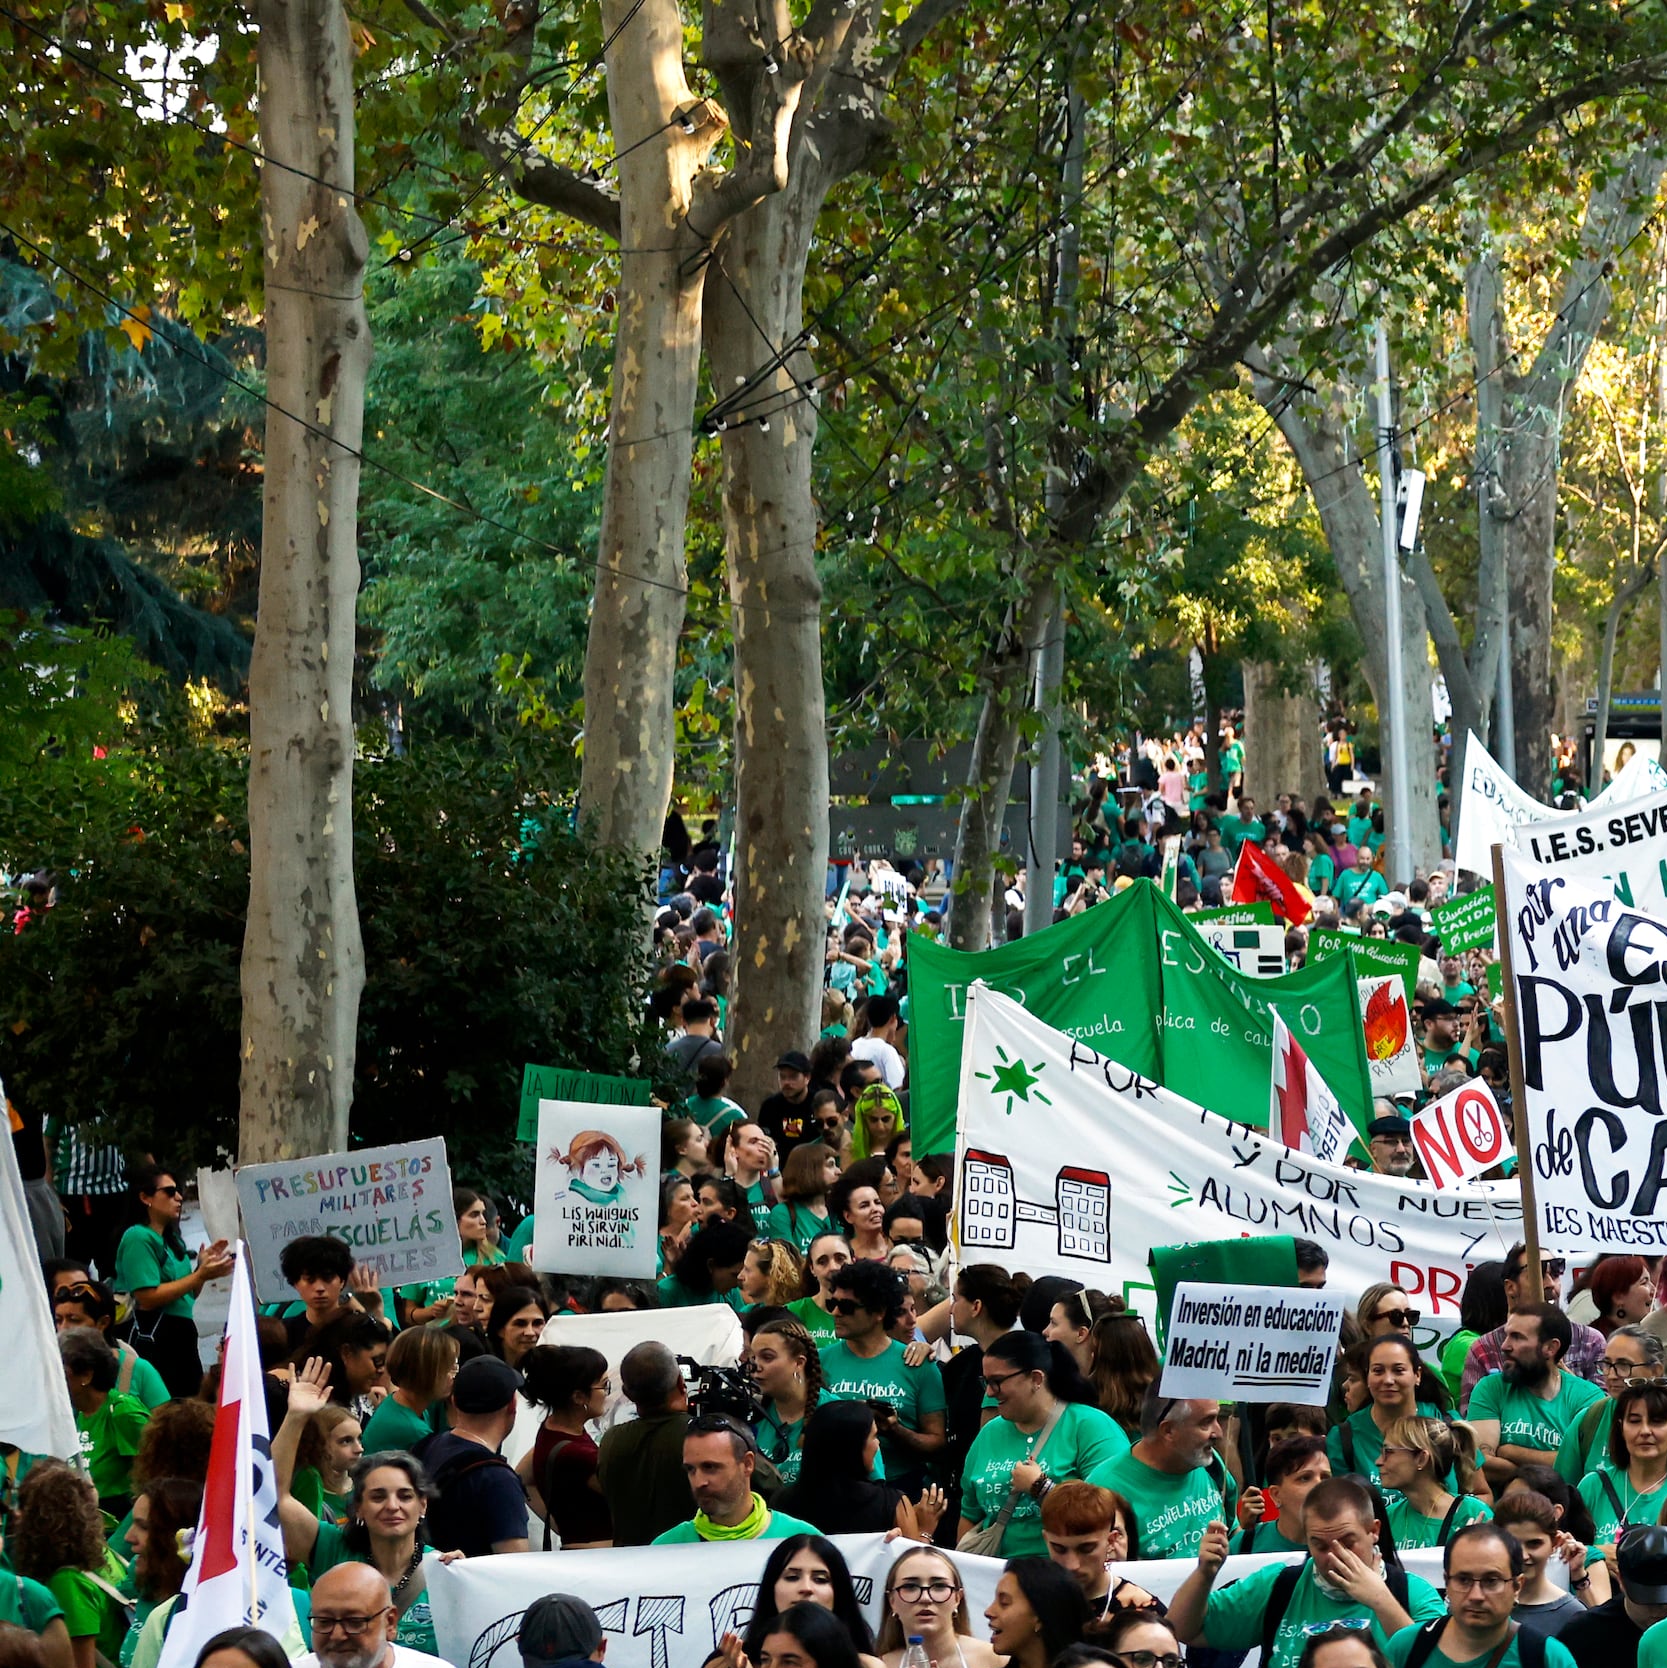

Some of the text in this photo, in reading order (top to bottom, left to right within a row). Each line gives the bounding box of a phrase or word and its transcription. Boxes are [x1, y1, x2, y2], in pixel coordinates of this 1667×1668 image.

[1531, 830, 1604, 864] I.E.S.
[1517, 877, 1566, 972] por
[1552, 898, 1613, 972] una
[1069, 1040, 1163, 1104] POR
[1413, 1088, 1502, 1190] NO
[1535, 1108, 1574, 1183] de
[256, 1155, 433, 1204] PRESUPUESTOS
[319, 1178, 425, 1214] MILITARES
[325, 1209, 445, 1247] ESCUELAS
[1200, 1176, 1405, 1253] ALUMNOS
[1177, 1293, 1338, 1334] Inversión en educación:
[1170, 1338, 1331, 1376] Madrid, ni la media!
